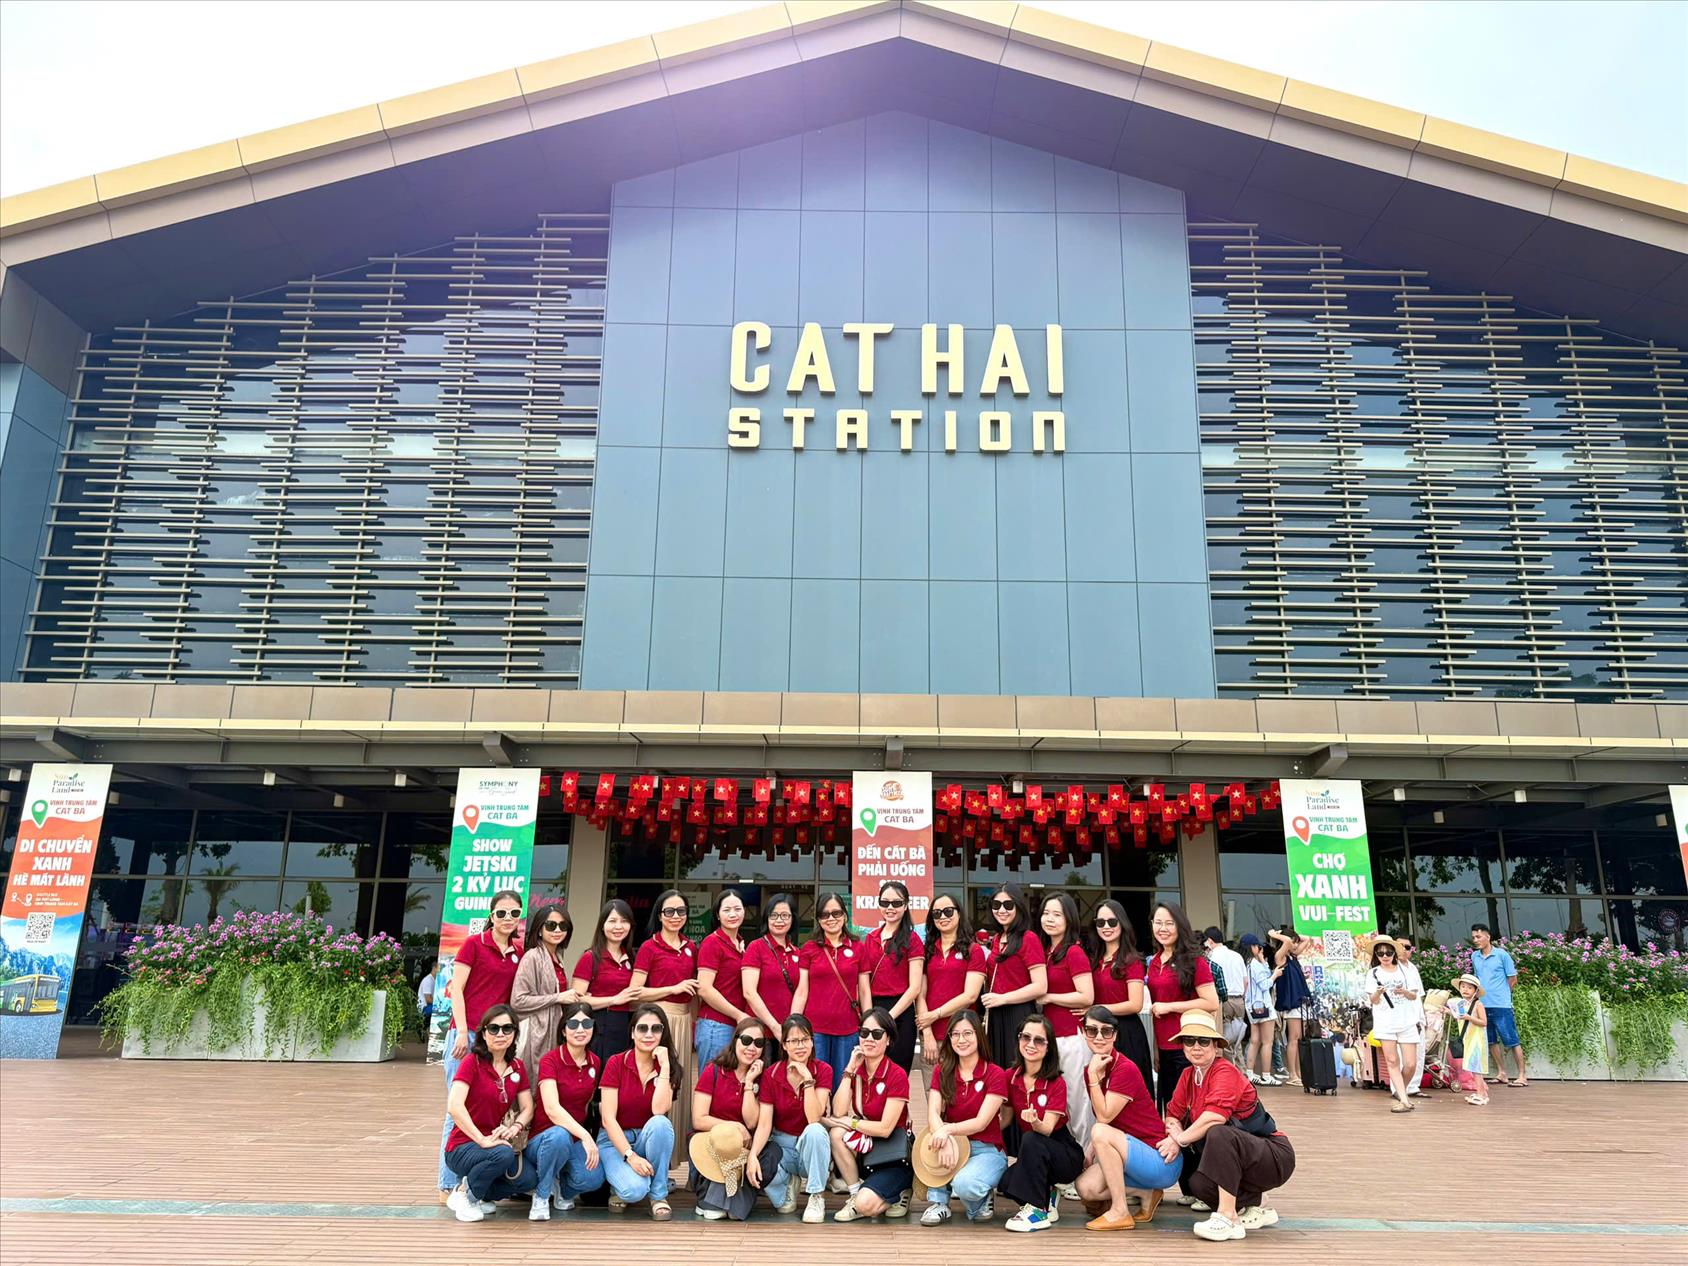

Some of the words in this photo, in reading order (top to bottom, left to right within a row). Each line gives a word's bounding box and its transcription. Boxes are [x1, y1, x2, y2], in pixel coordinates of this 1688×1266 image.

[730, 321, 895, 396] CAT
[921, 323, 1064, 397] HAI
[728, 408, 1065, 453] STATION
[53, 779, 85, 787] Paradise
[1306, 795, 1340, 804] Paradise
[19, 839, 34, 853] DI
[37, 834, 93, 854] CHUYỂN
[472, 838, 512, 852] SHOW
[857, 843, 881, 860] ĐẾN
[884, 844, 907, 860] CÁT
[909, 844, 926, 860] BÀ
[32, 857, 73, 871] XANH
[462, 856, 517, 872] JETSKI
[857, 861, 887, 876] PHẢI
[889, 860, 926, 876] UỐNG
[1312, 852, 1346, 870] CHỢ
[30, 872, 55, 886] MÁT
[452, 876, 464, 893] 2
[1296, 874, 1368, 899] XANH
